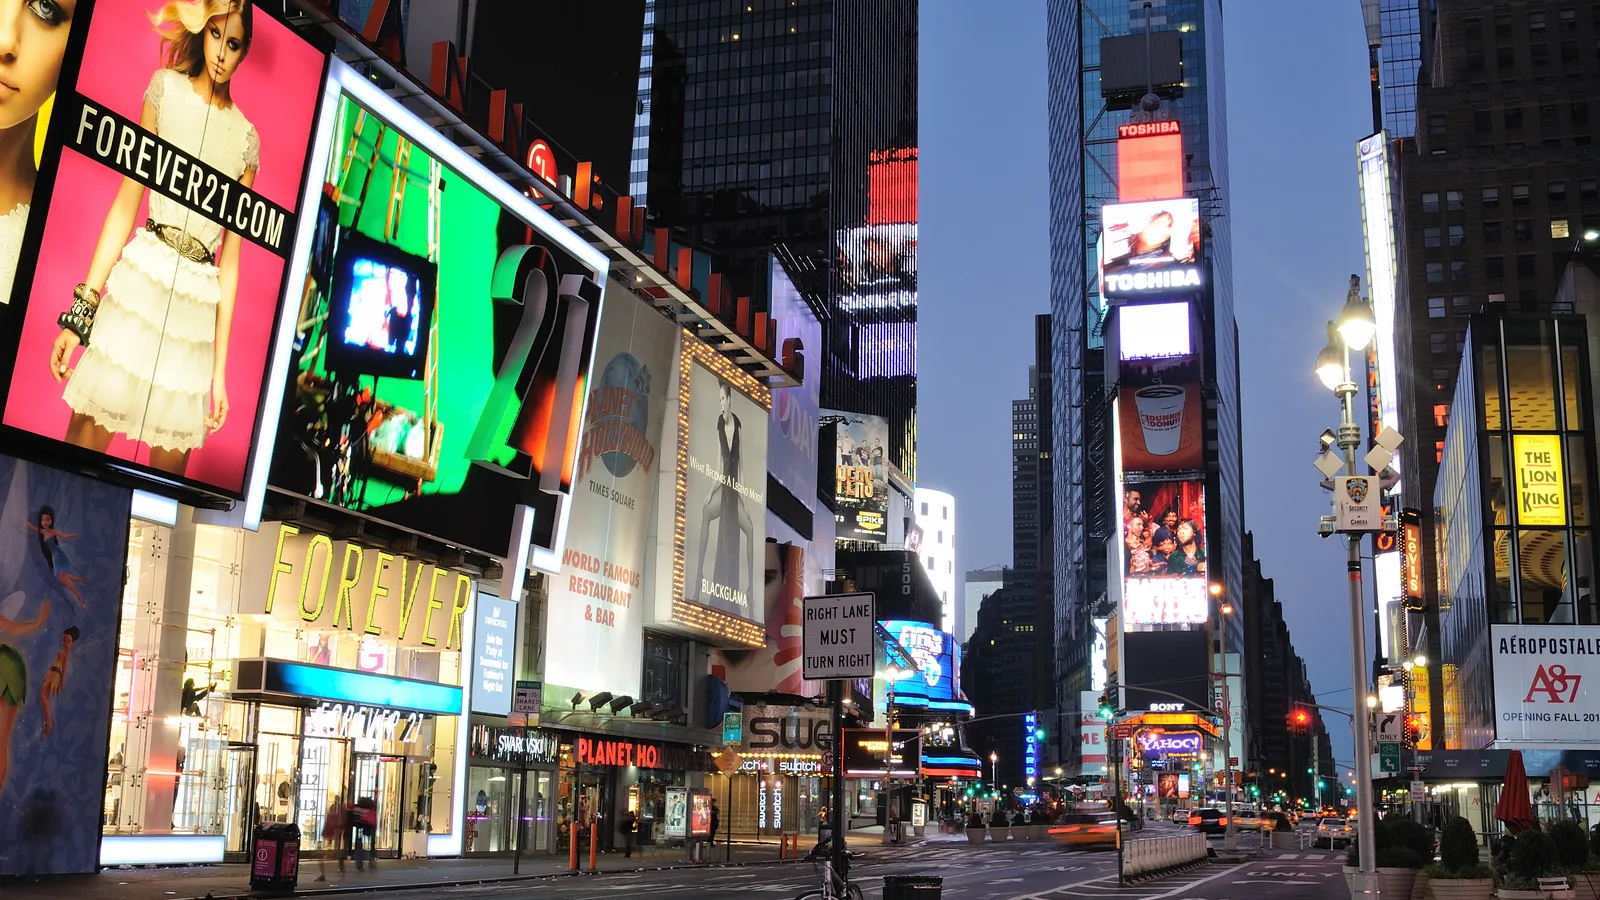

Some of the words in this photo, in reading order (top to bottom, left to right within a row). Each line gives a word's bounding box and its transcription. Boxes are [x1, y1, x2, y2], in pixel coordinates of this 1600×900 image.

[1119, 121, 1179, 137] TOSHIBA
[76, 104, 285, 249] FOREVER21.COM
[1104, 269, 1200, 292] TOSHIBA
[464, 244, 603, 496] 21
[583, 386, 638, 423] PLANET
[577, 422, 655, 484] HOLLYWOOD
[1524, 452, 1551, 463] THE
[726, 475, 732, 488] A
[1521, 468, 1557, 488] LION
[589, 480, 610, 499] TIMES
[610, 489, 635, 511] SQUARE
[1522, 492, 1560, 512] KING
[856, 515, 884, 525] SPIKE
[561, 547, 600, 574] WORLD
[603, 561, 640, 589] FAMOUS
[902, 552, 911, 595] 1500
[264, 523, 472, 652] FOREVER
[568, 575, 632, 609] RESTAURANT
[701, 578, 748, 608] BLACKGLAMA
[584, 604, 593, 622] &
[595, 606, 615, 628] BAR
[807, 607, 838, 620] RIGHT
[842, 605, 870, 618] LANE
[820, 628, 856, 645] MUST
[807, 655, 834, 669] TURN
[838, 654, 870, 667] RIGHT
[1522, 664, 1582, 703] A87
[1150, 703, 1184, 712] SONY
[1502, 712, 1551, 722] OPENING
[1554, 713, 1581, 722] FALL
[403, 713, 425, 743] 21
[578, 737, 633, 767] PLANET
[779, 760, 816, 772] swatch
[773, 788, 782, 828] swatch
